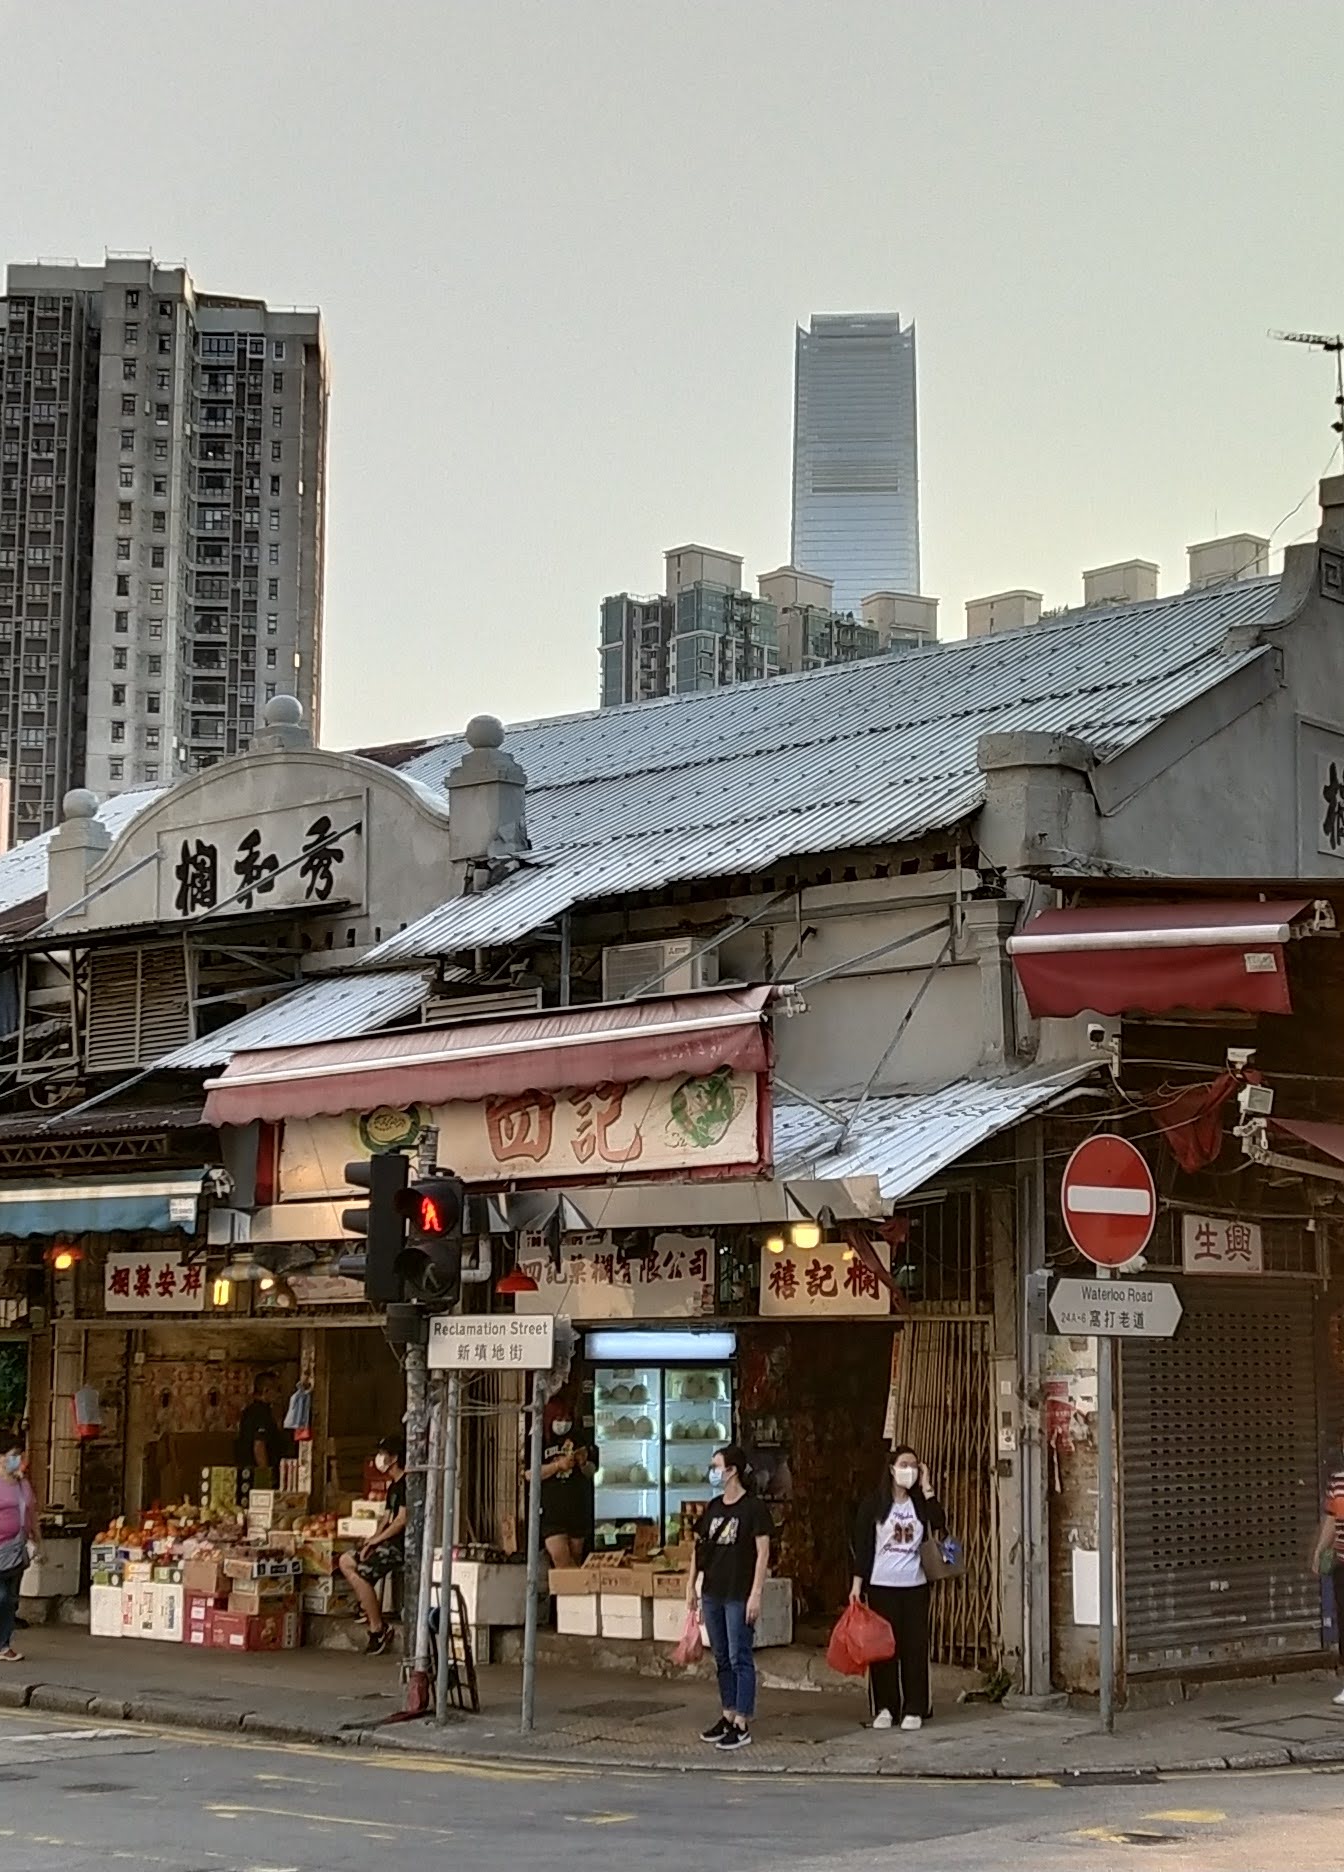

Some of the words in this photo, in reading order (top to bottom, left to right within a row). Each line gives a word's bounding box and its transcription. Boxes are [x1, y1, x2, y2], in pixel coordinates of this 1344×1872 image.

[485, 1081, 643, 1163] 四記
[768, 1258, 880, 1300] 禧記欄
[1081, 1286, 1126, 1301] Waterloo
[1127, 1288, 1153, 1302] Road
[434, 1322, 506, 1336] Reclamation
[510, 1321, 548, 1335] Street
[1089, 1310, 1144, 1329] 窩打老道
[457, 1344, 523, 1361] 新填地街
